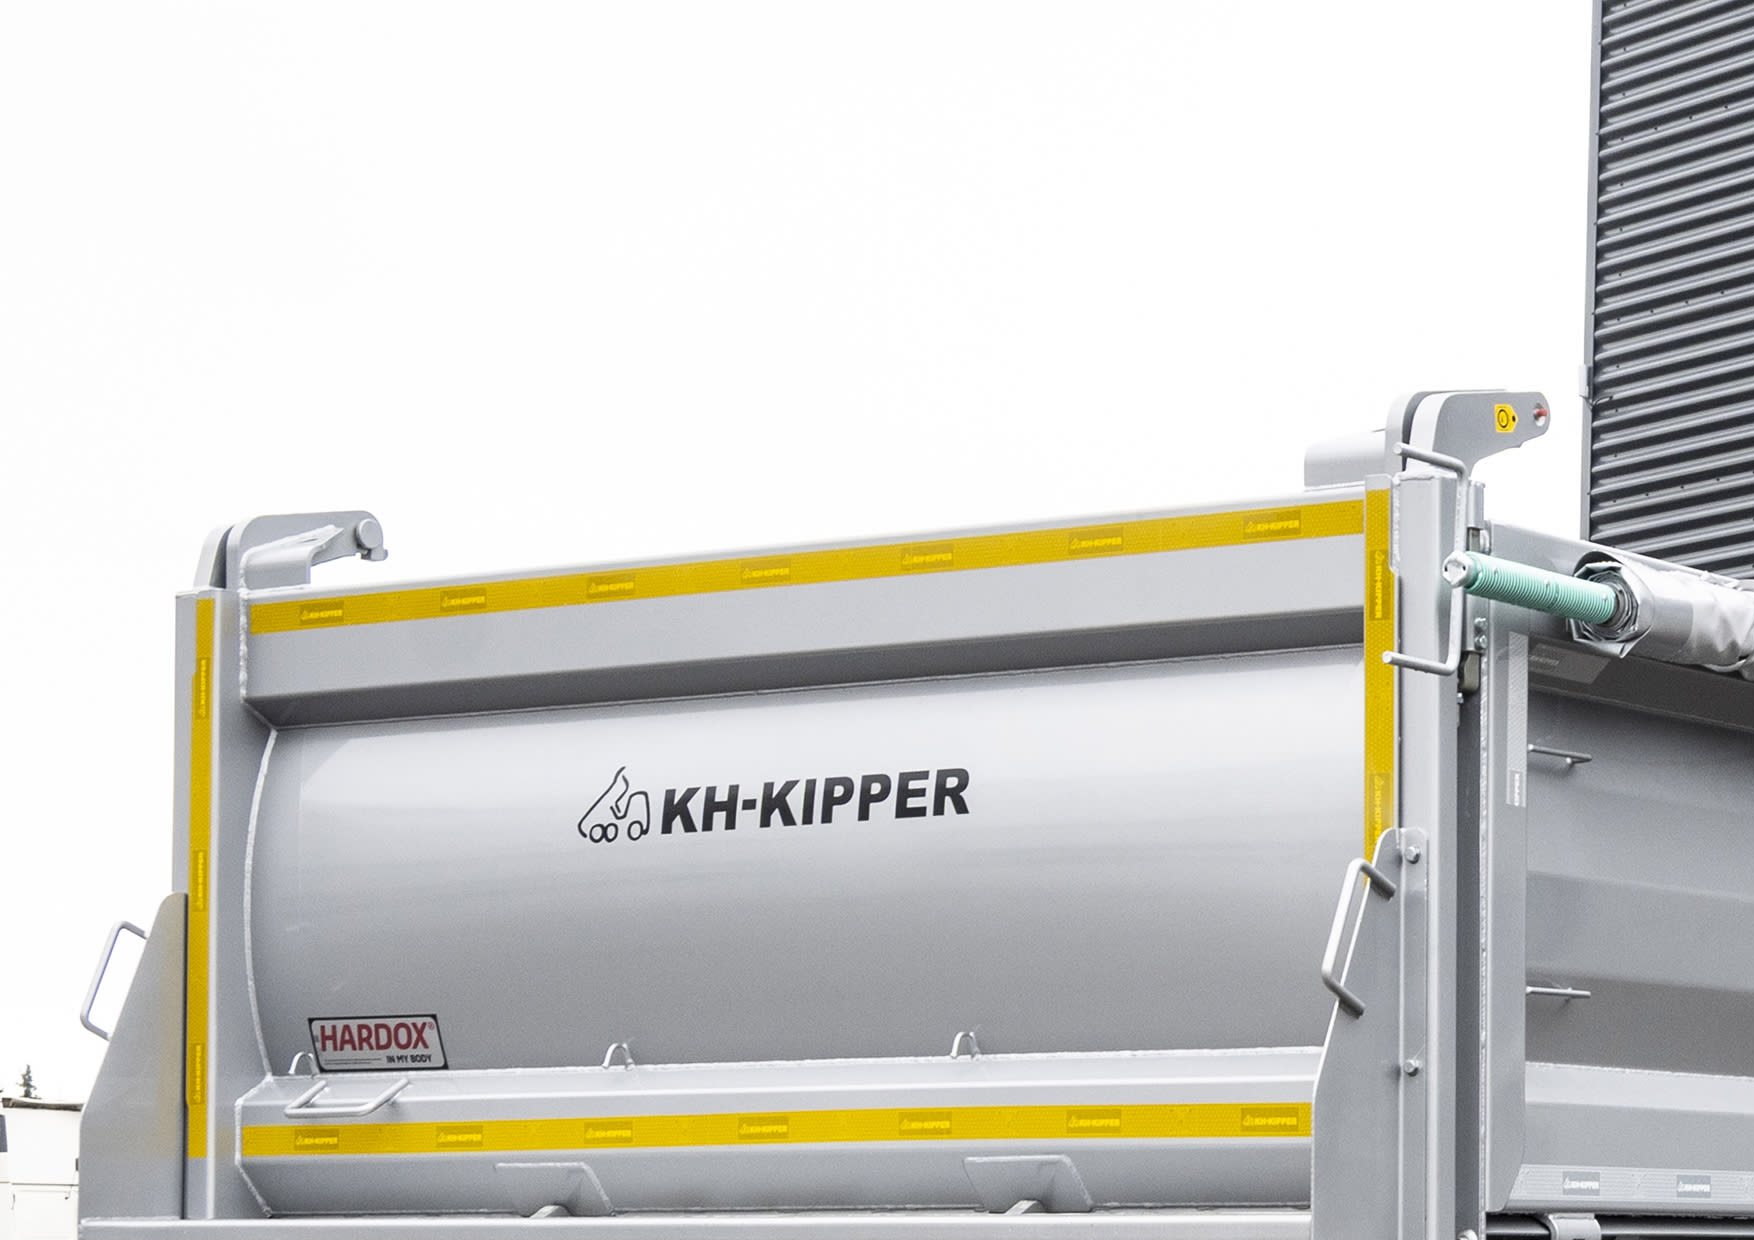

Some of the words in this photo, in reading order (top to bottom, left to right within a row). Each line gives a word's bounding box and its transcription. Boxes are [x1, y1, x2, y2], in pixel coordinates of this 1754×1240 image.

[661, 767, 971, 835] KH-KIPPER
[386, 1055, 395, 1064] IN
[396, 1055, 409, 1063] MY
[409, 1054, 432, 1063] BODY
